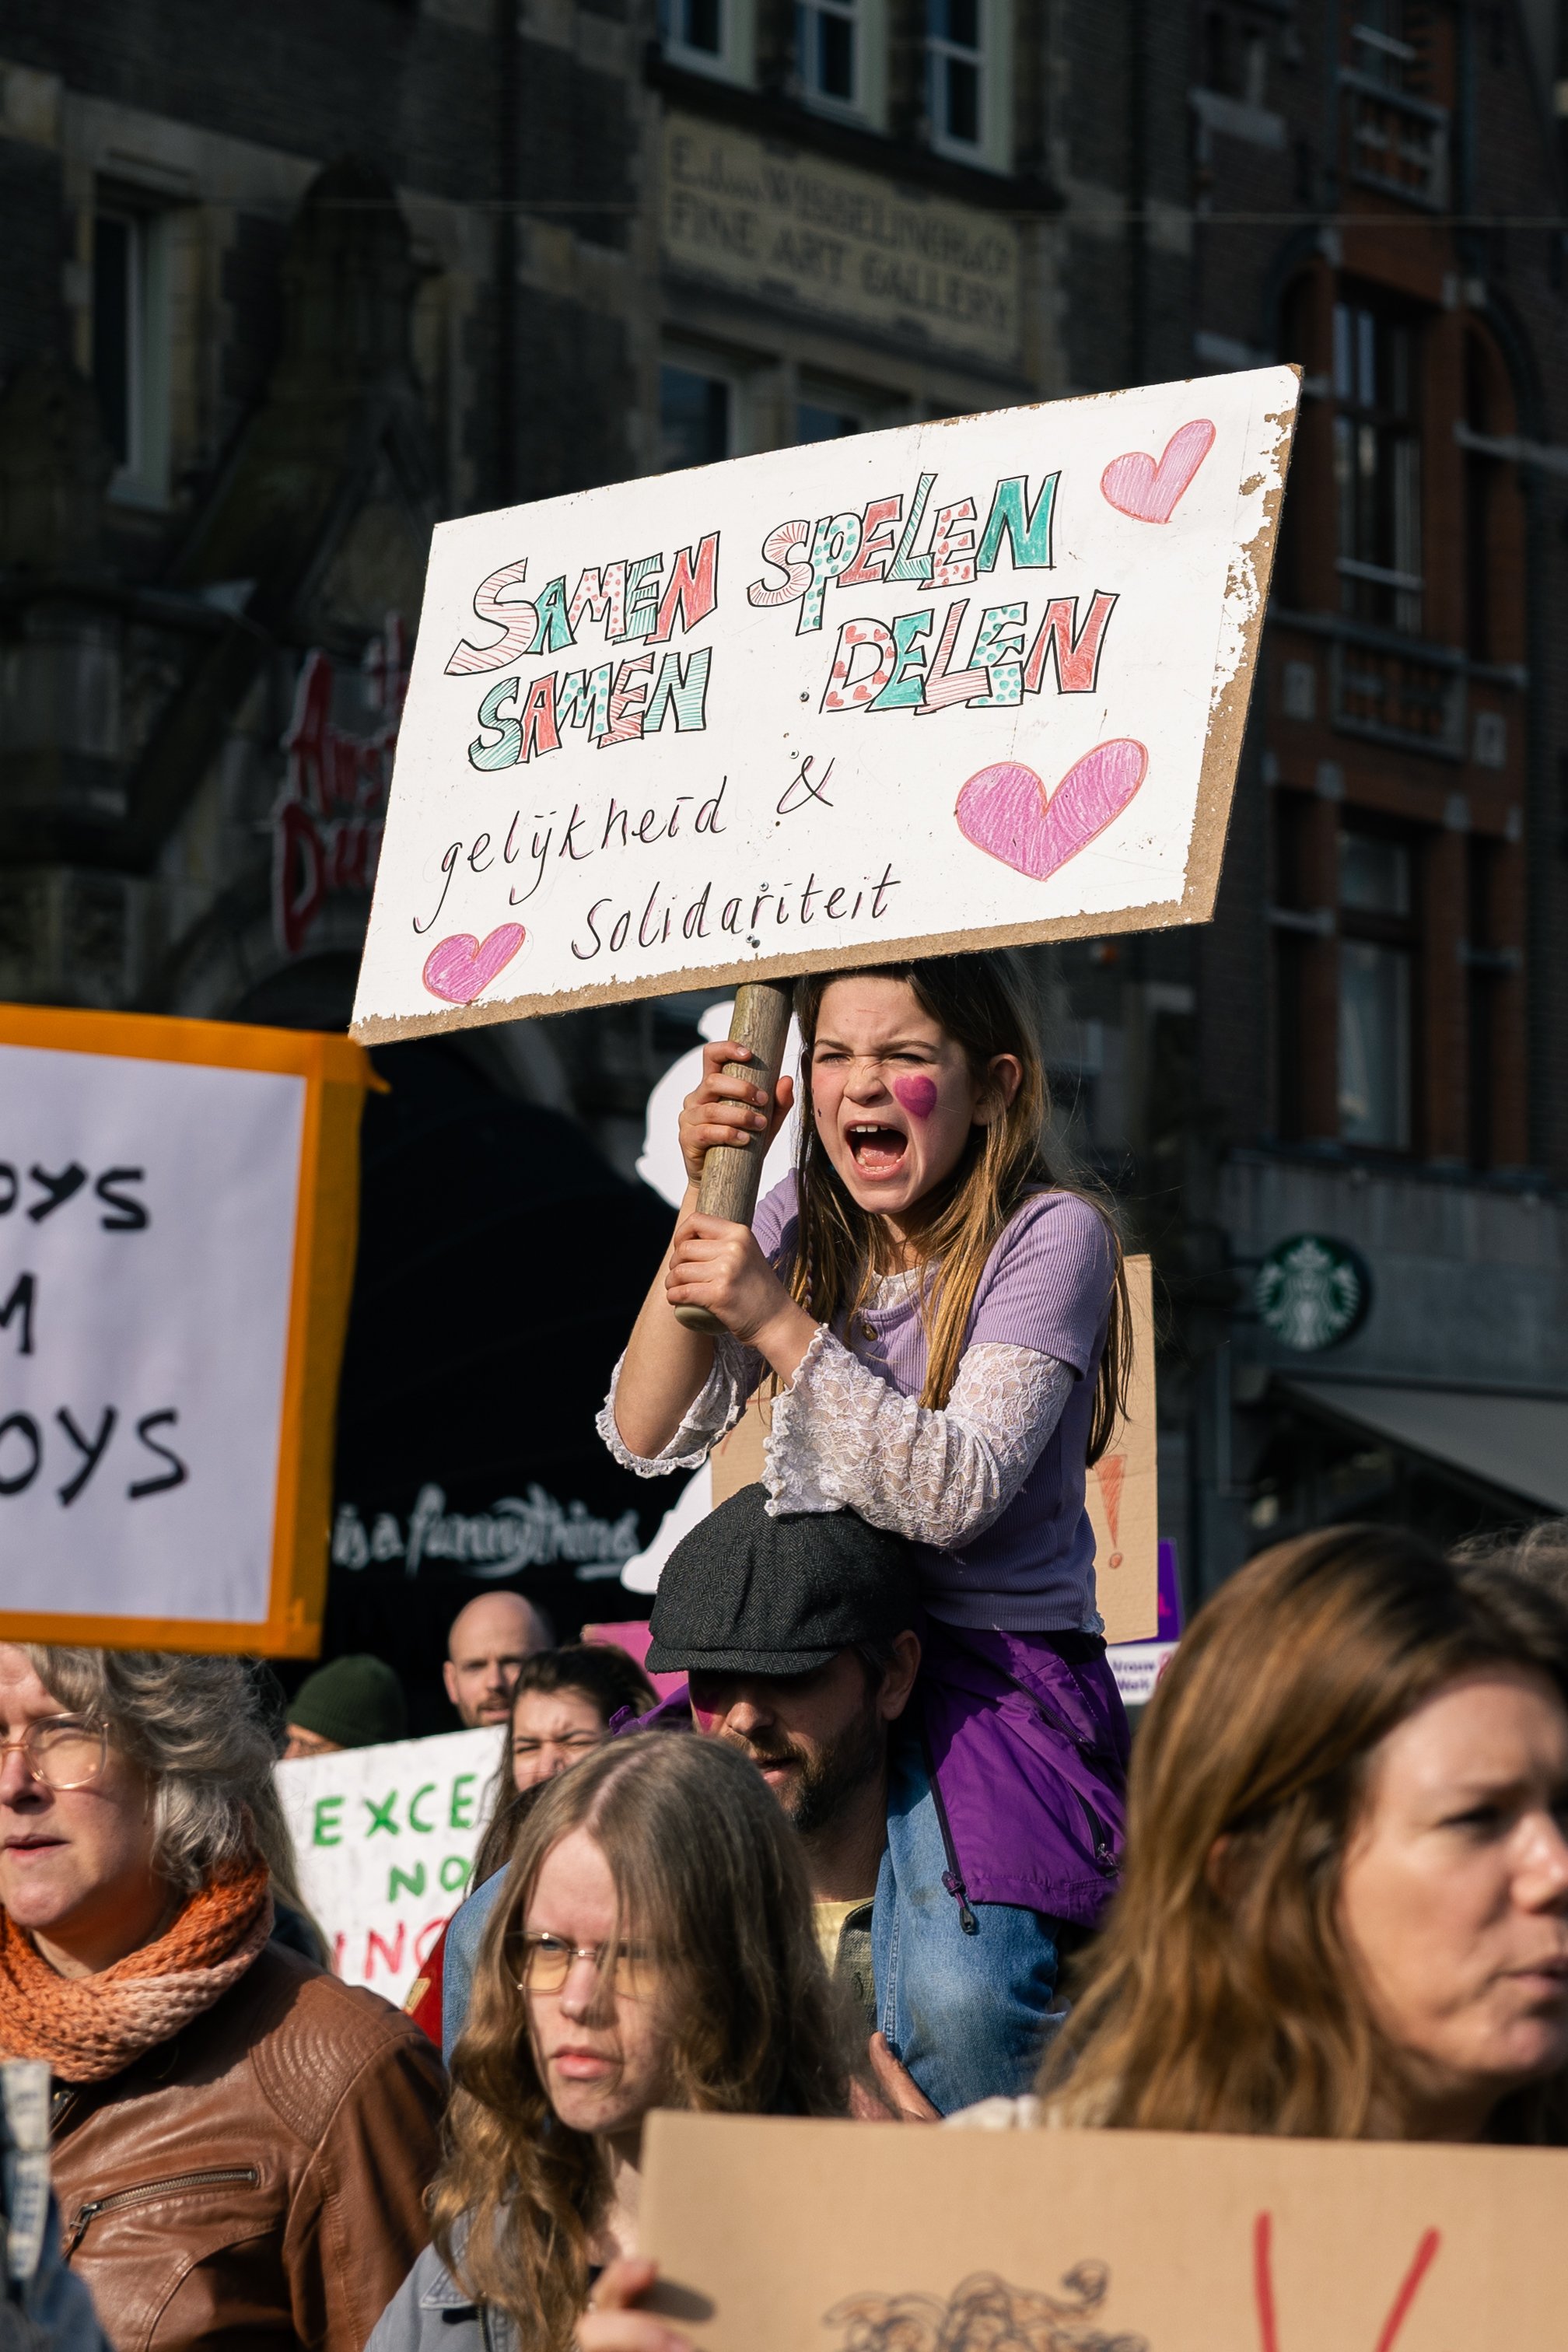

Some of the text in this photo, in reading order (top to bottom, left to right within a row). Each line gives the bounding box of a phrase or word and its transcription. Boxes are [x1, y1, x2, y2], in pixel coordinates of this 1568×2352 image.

[669, 190, 760, 261] FINE
[772, 227, 845, 288] ART
[859, 250, 1009, 333] GALLERY
[444, 471, 1062, 676] SAMEN SPELEN
[468, 589, 1121, 772] SAMEN DELEN
[413, 754, 835, 933] gelijkheid &
